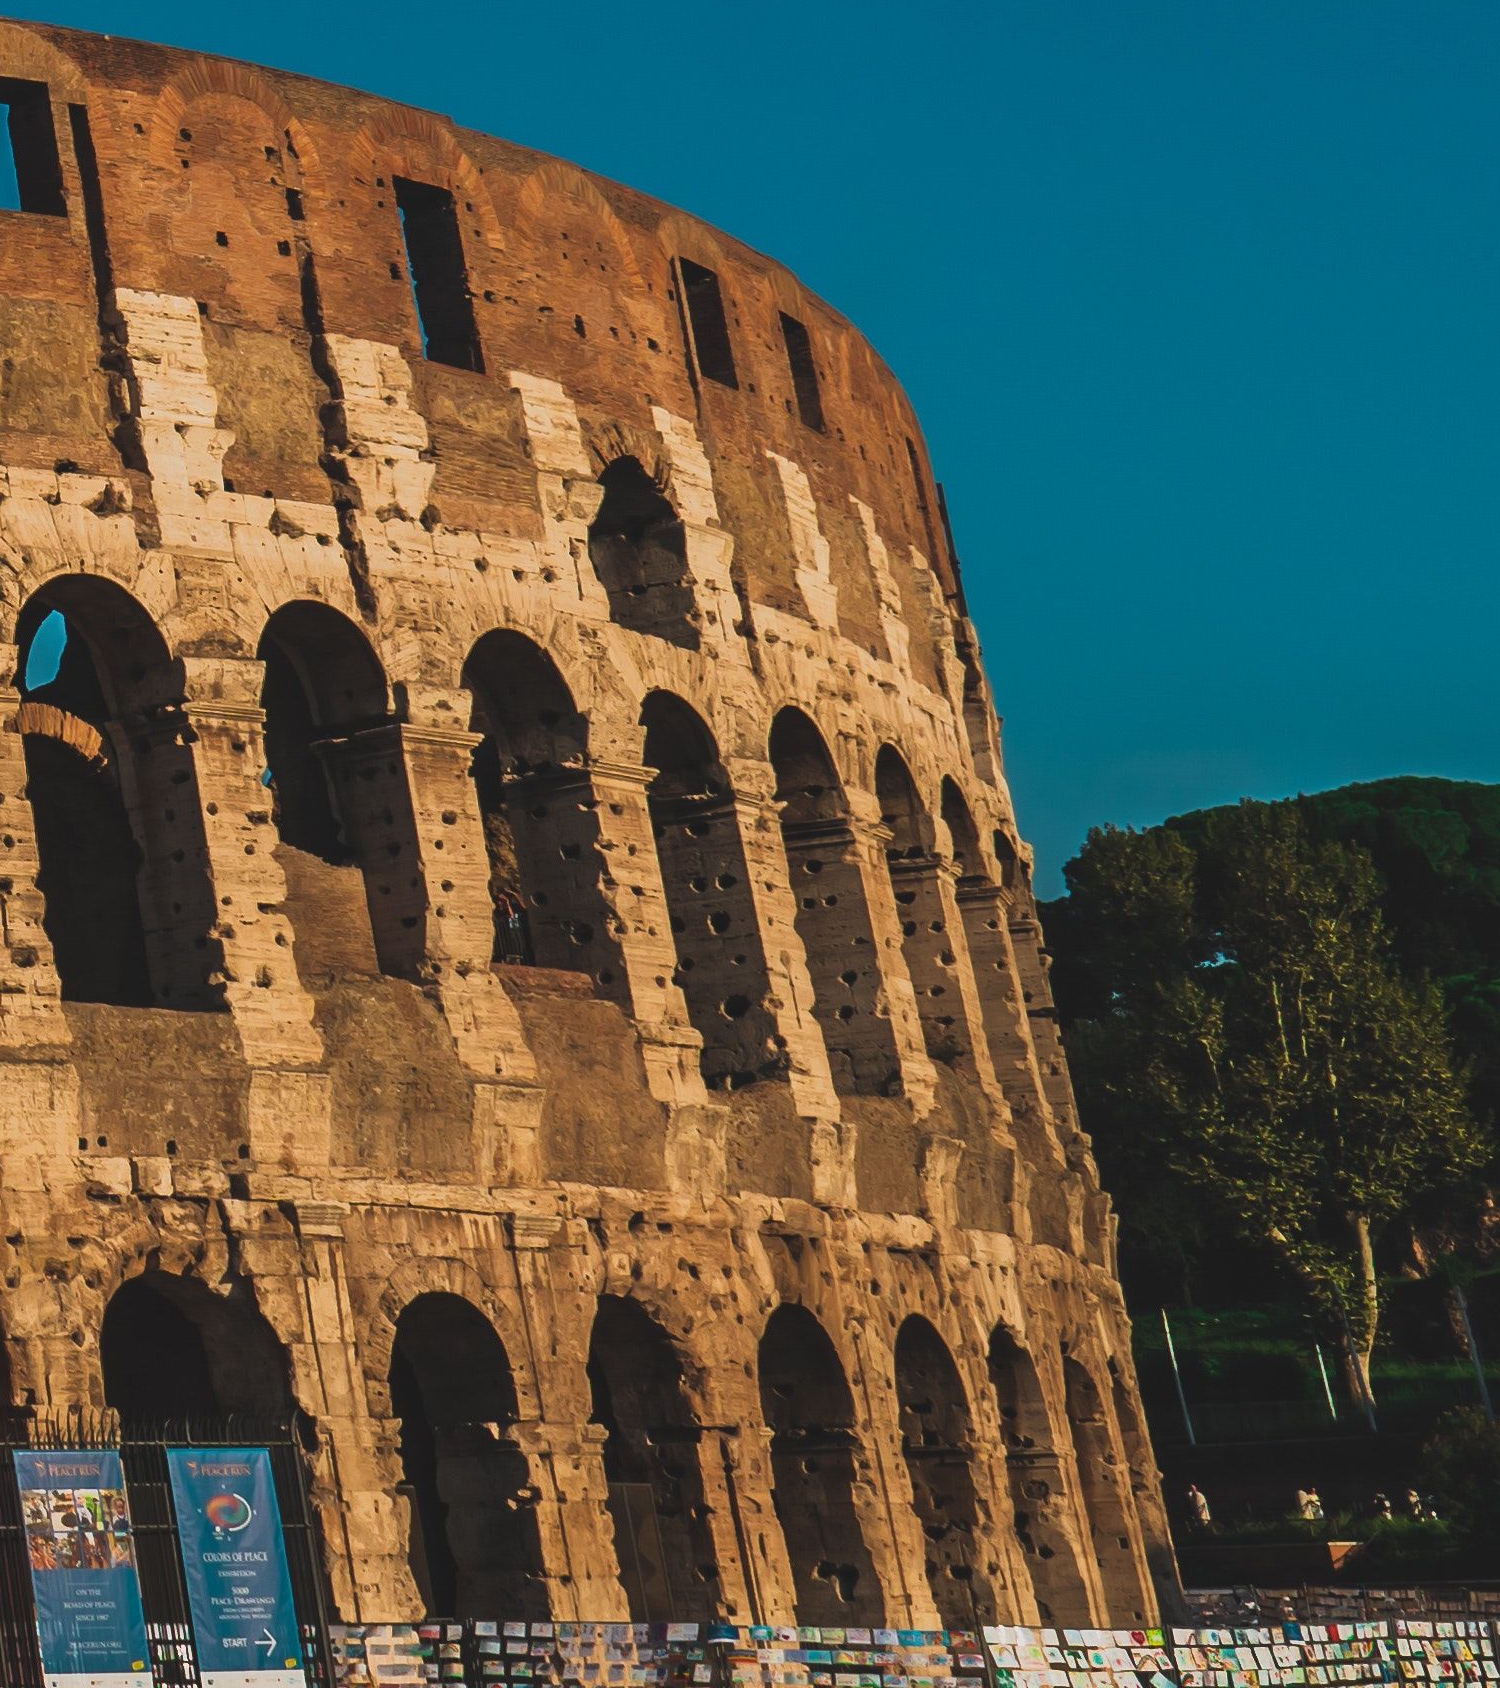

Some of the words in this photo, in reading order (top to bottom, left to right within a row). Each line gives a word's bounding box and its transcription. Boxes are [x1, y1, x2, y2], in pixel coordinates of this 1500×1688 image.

[202, 1552, 231, 1562] COLORS
[232, 1552, 242, 1562] OF
[245, 1551, 268, 1562] PEACE
[222, 1637, 247, 1648] START
